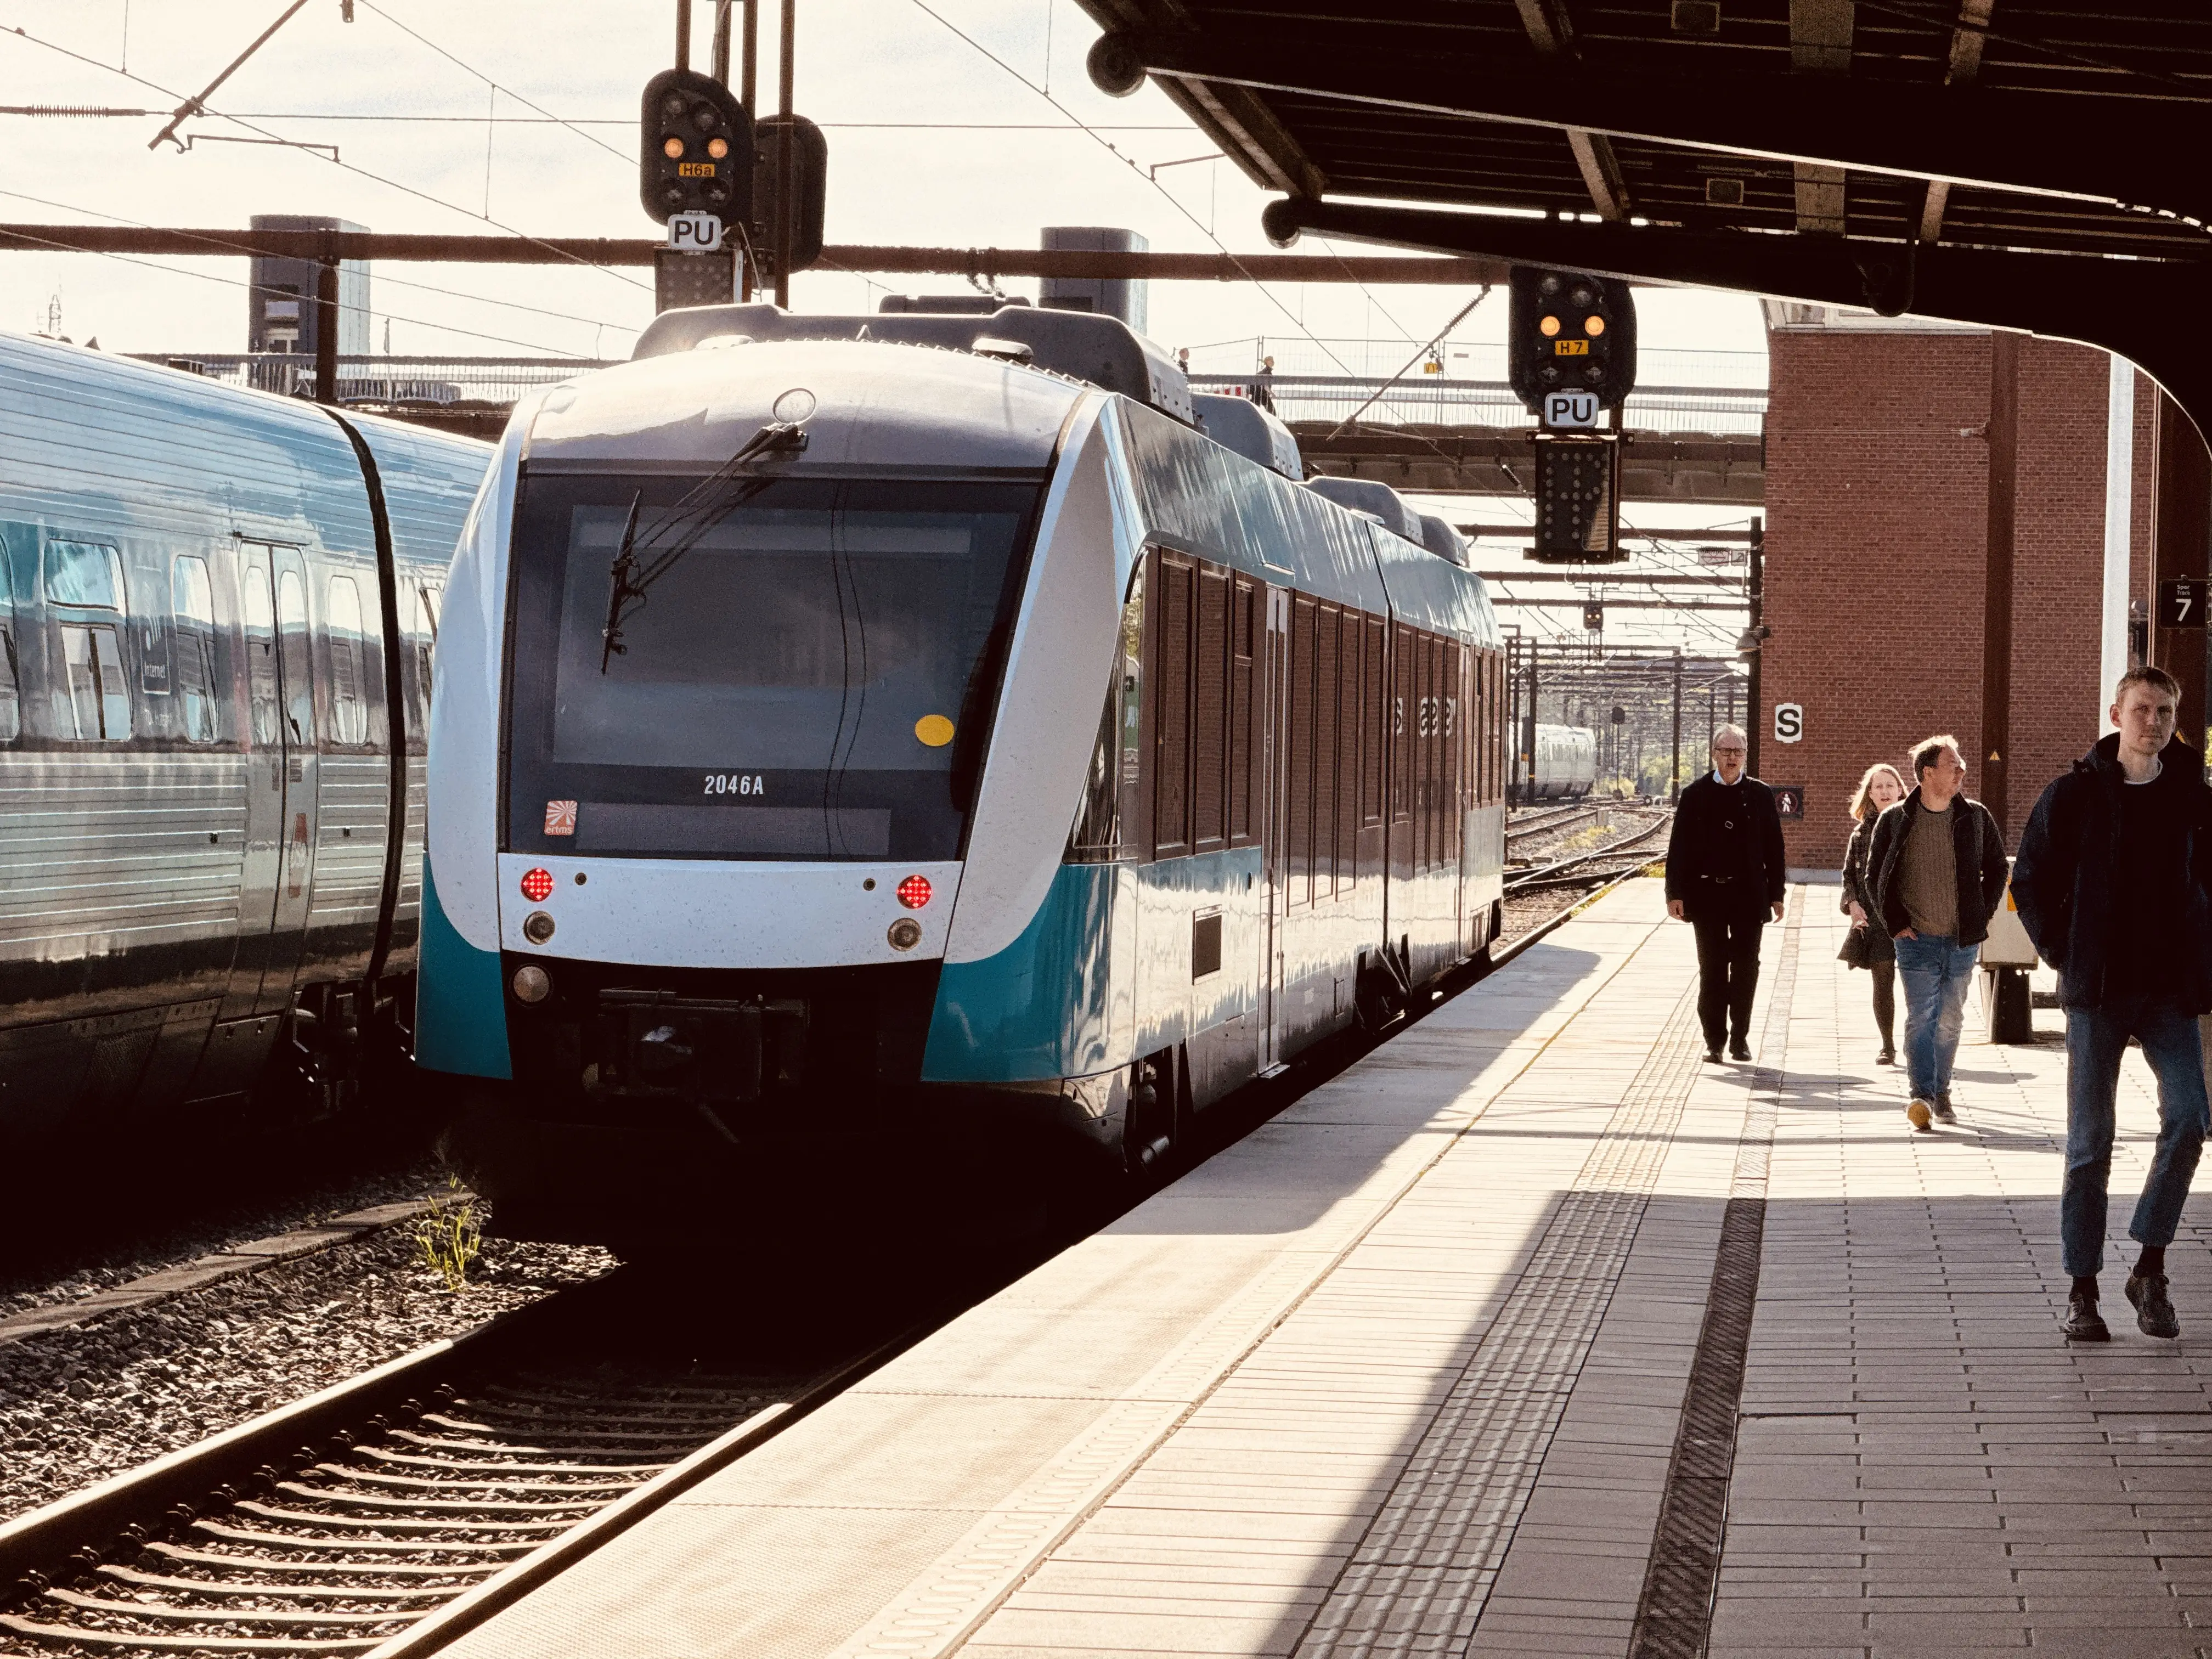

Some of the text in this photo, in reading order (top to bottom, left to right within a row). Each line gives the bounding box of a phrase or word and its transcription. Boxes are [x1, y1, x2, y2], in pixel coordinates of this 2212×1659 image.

[684, 164, 712, 176] H6a
[675, 221, 714, 245] PU
[1552, 399, 1592, 422] PU
[2175, 599, 2192, 622] 7
[144, 661, 166, 678] Internet
[1777, 709, 1800, 737] S
[704, 775, 764, 794] 2046A
